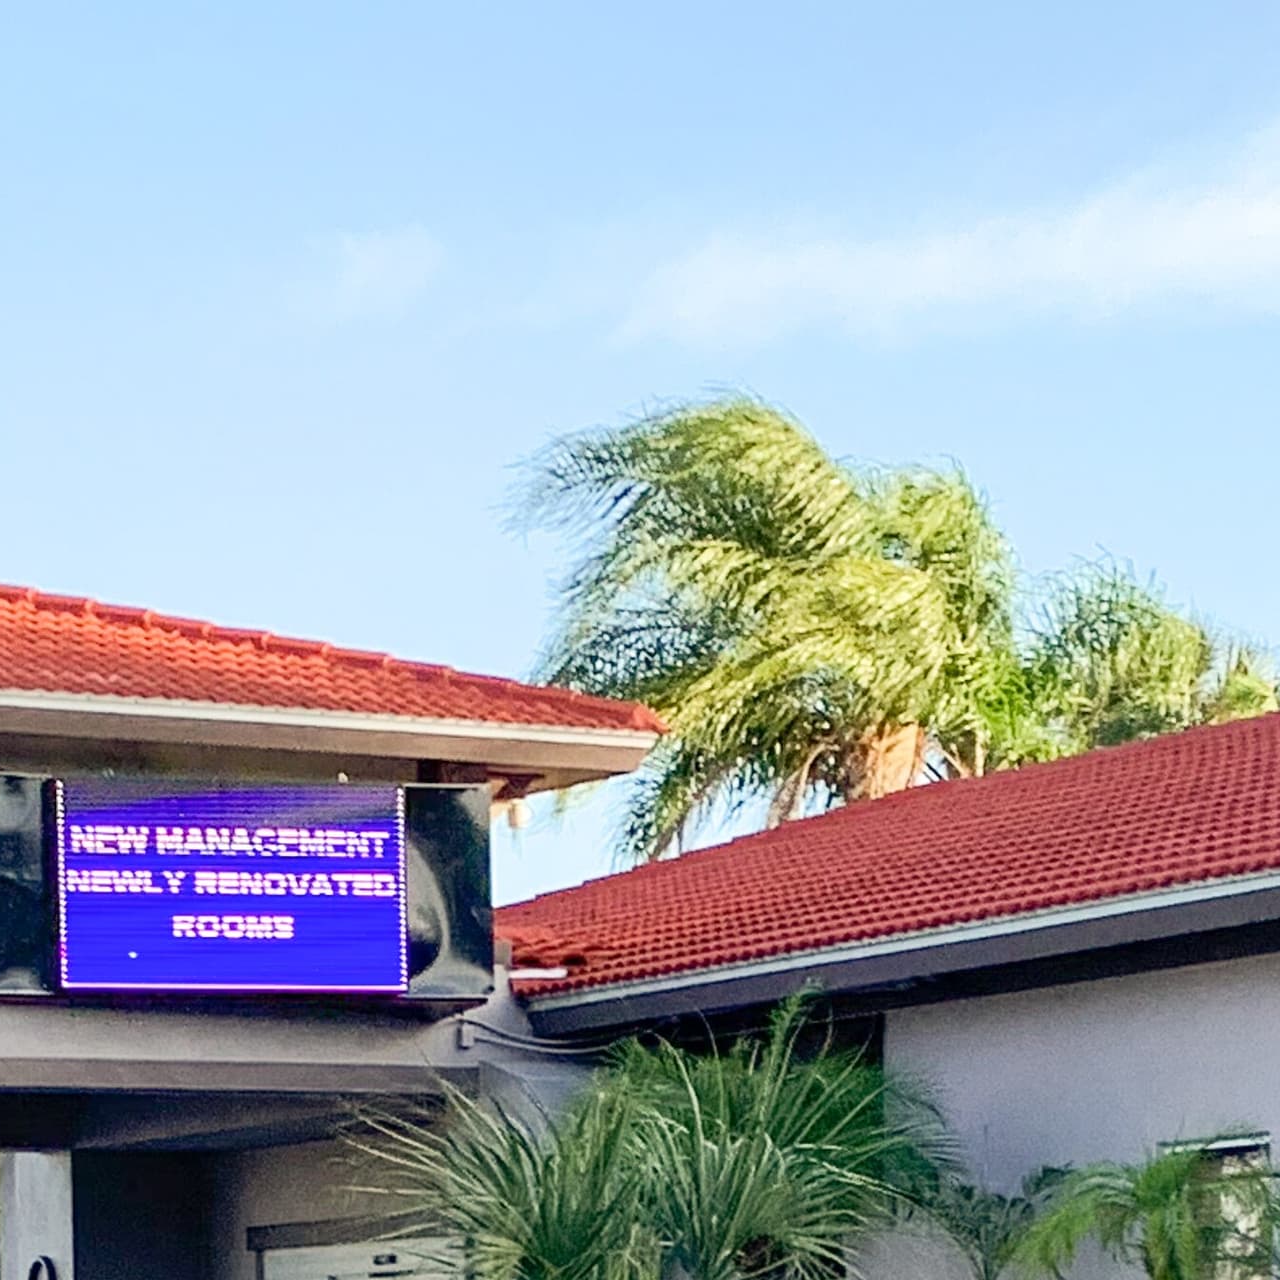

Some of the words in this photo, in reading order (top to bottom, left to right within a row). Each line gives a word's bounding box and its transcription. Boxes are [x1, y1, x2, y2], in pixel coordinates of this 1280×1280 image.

[69, 824, 150, 854] NEW
[155, 826, 390, 859] MANAGEMENT
[66, 869, 187, 895] NEWLY
[193, 871, 398, 897] RENOVATED
[172, 915, 295, 939] ROOMS
